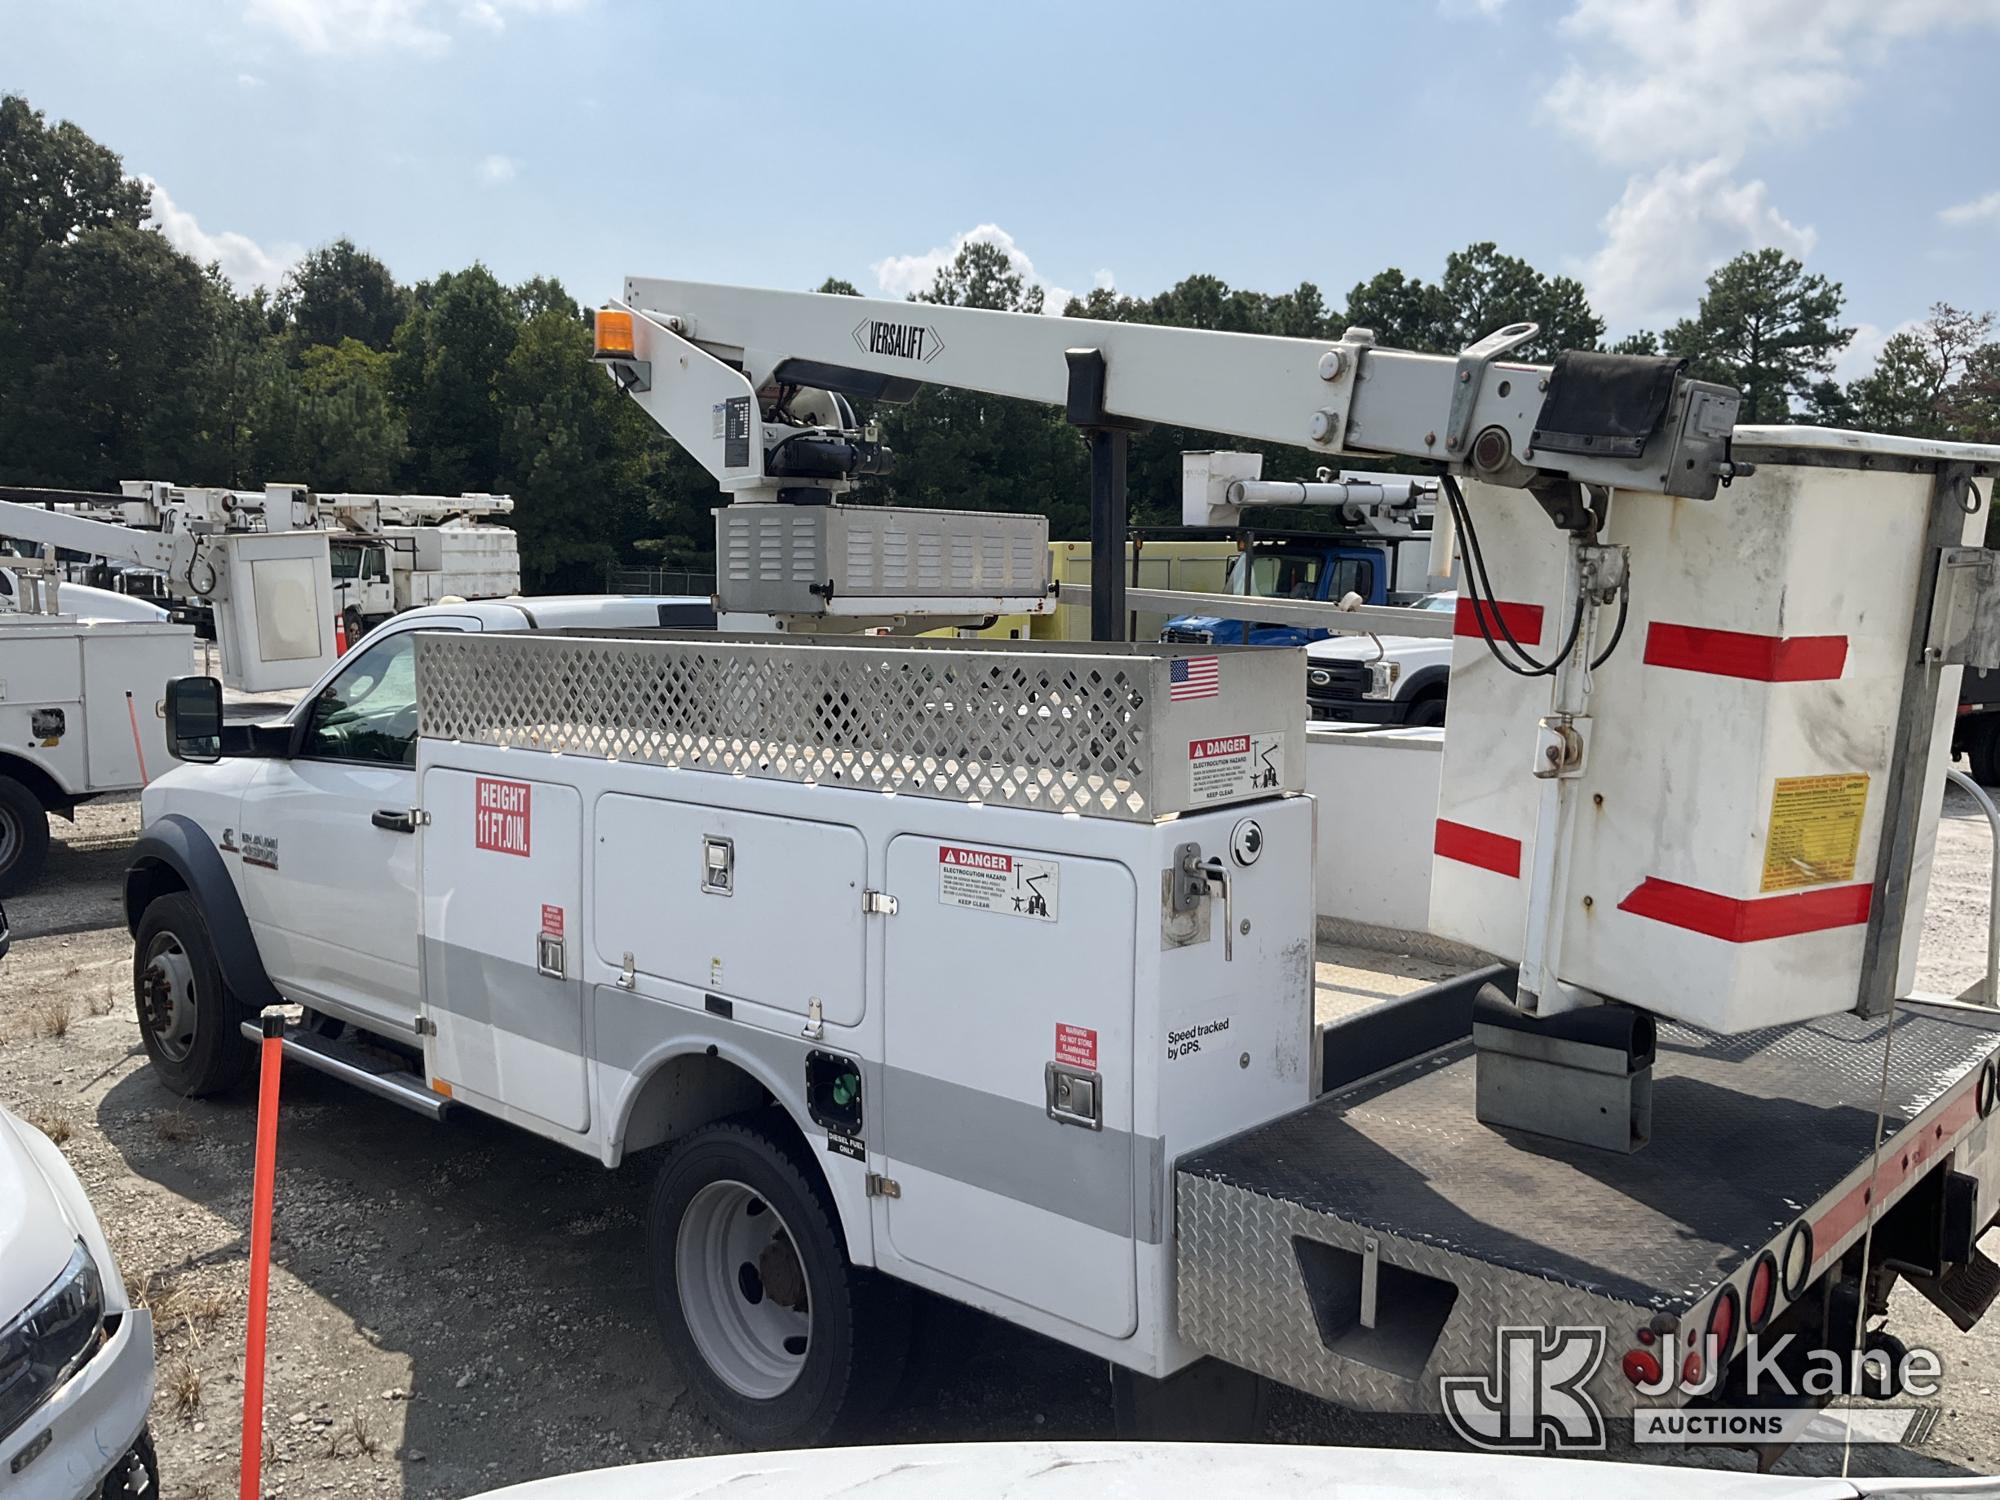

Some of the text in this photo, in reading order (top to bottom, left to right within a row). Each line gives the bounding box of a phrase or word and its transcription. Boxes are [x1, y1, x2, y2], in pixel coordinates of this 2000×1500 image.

[869, 321, 926, 360] VERSALIFT
[1206, 738, 1247, 755] DANGER
[1193, 756, 1247, 769] ELECTROCUTION HAZARD
[480, 782, 526, 812] HEIGHT
[1219, 789, 1234, 797] CLEAR
[479, 810, 489, 843] 11
[960, 852, 1007, 870] DANGER
[943, 867, 1007, 881] ELECTROCUTION HAZARD
[972, 901, 990, 909] CLEAR
[1065, 1026, 1087, 1038] WARNING
[1168, 1017, 1229, 1045] Speed tracked
[1060, 1033, 1092, 1048] DO NOT STORE
[1056, 1052, 1080, 1064] MATERIALS
[1167, 1040, 1201, 1060] by GPS.
[828, 1132, 864, 1151] DIESEL FUEL
[839, 1144, 854, 1155] ONLY
